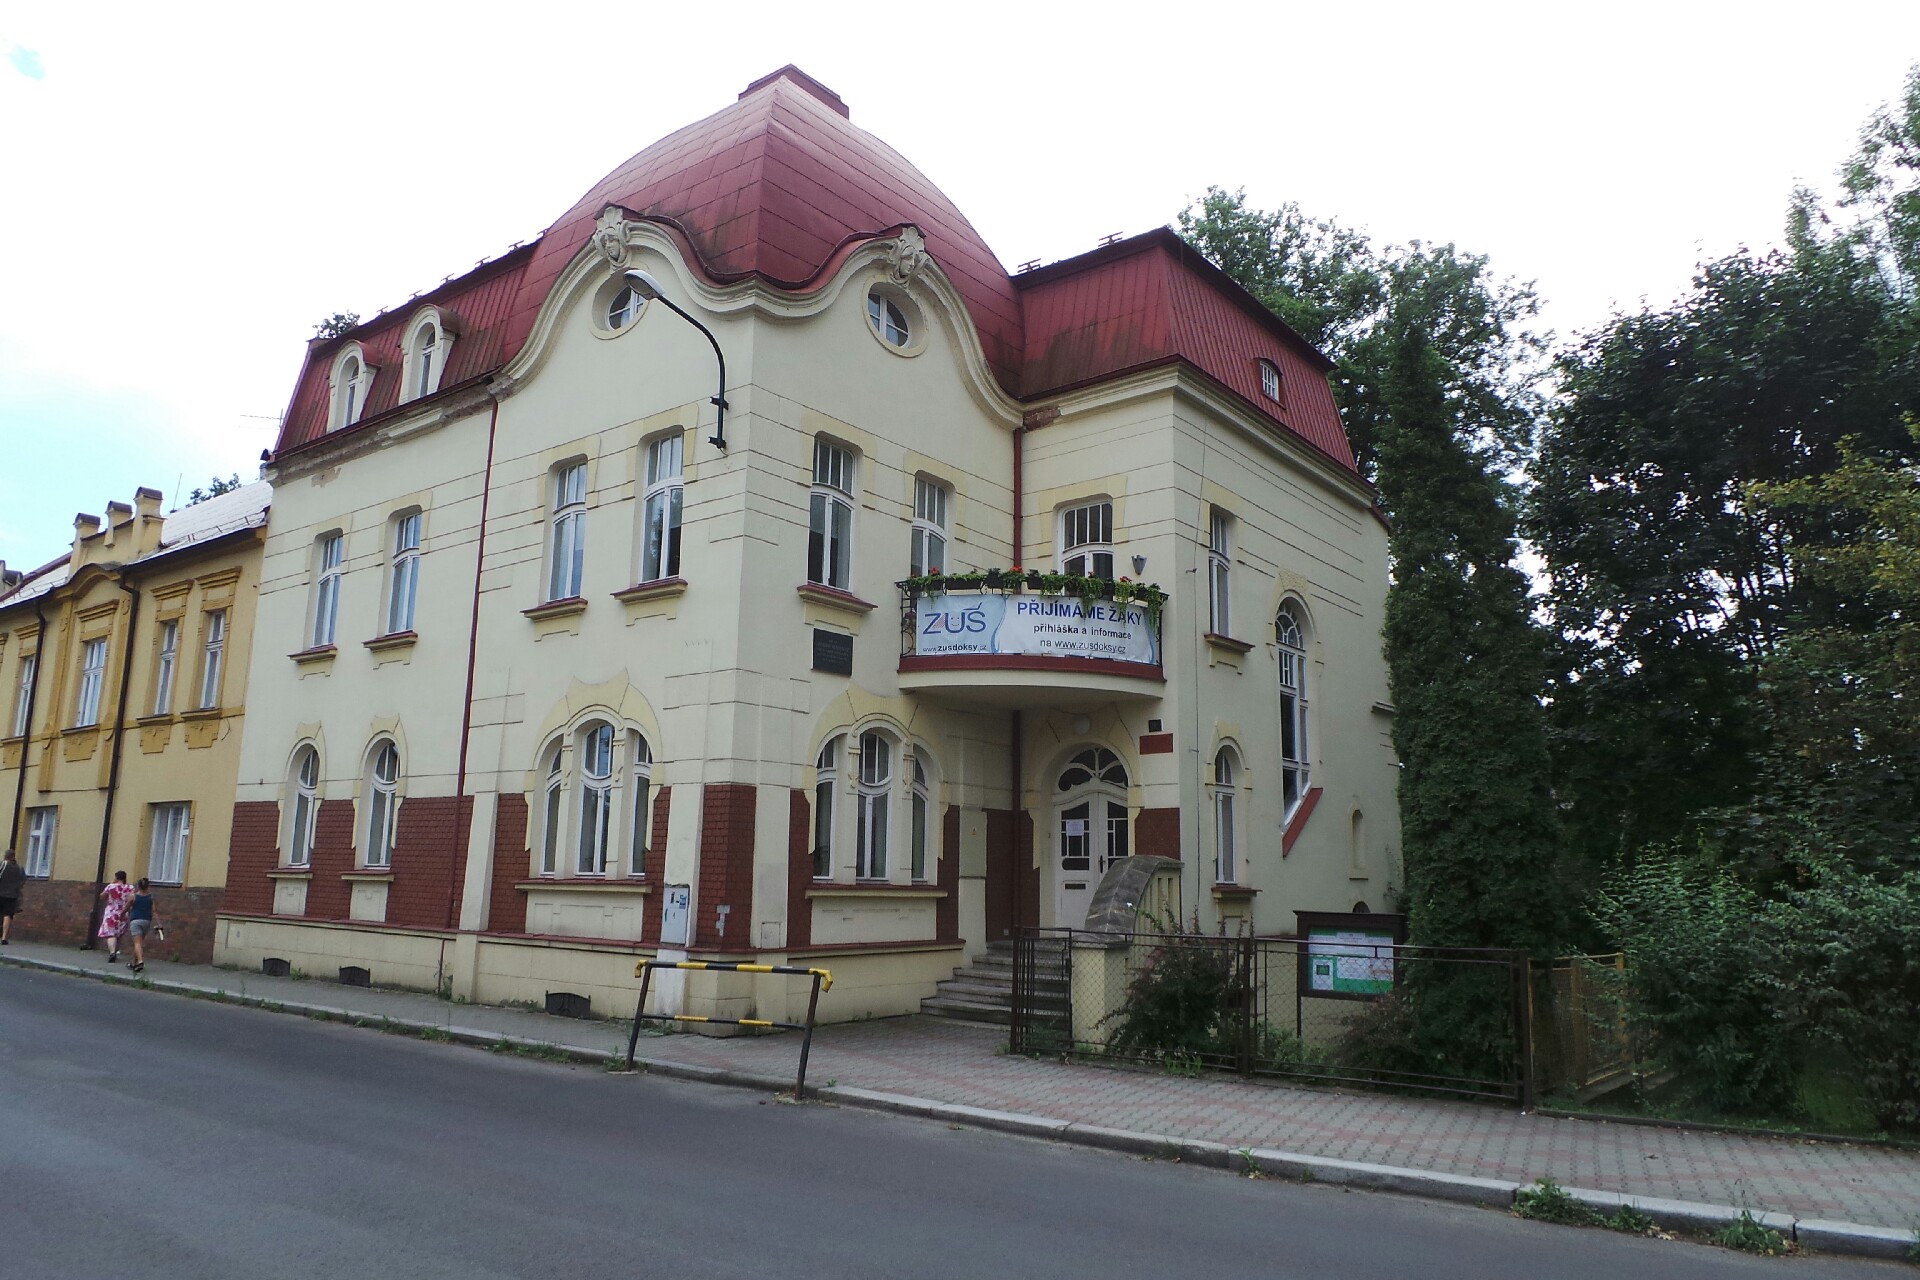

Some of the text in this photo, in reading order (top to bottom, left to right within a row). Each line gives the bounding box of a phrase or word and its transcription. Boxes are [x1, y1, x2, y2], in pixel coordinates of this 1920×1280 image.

[1017, 599, 1105, 620] PŘIJÍMÁME
[1033, 624, 1079, 634] přihláška
[1091, 626, 1132, 640] informace
[1040, 639, 1126, 654] na www.zusdoksy.cz
